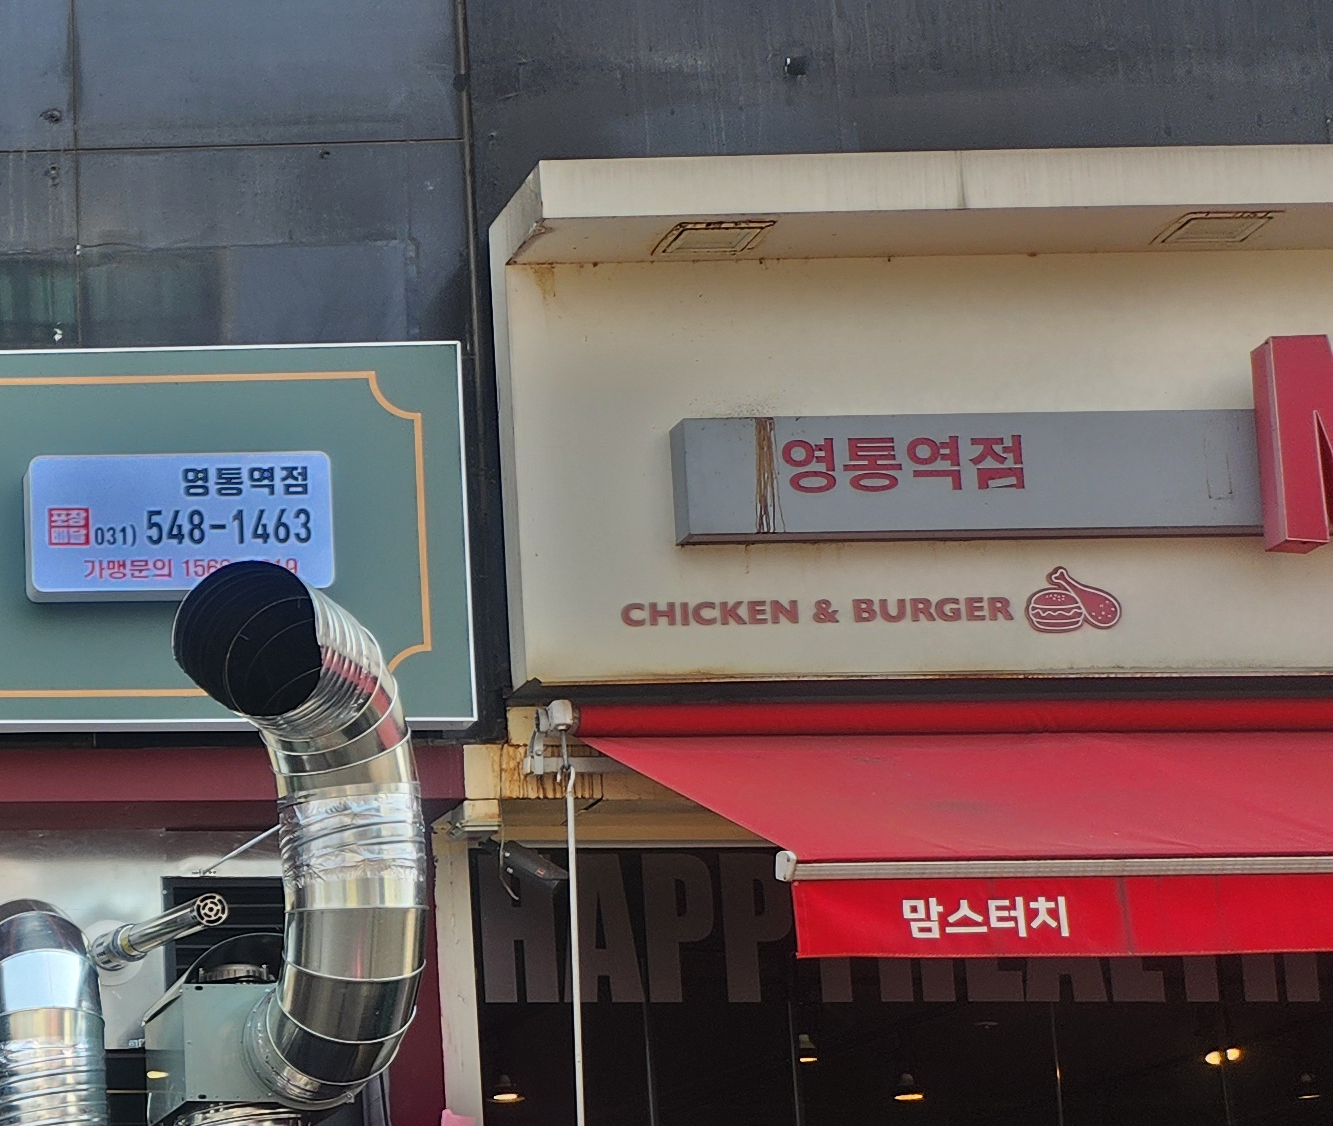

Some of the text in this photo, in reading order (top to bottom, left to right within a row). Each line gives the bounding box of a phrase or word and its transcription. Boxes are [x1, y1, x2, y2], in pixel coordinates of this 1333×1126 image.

[182, 465, 309, 496] 영통역점
[780, 433, 1026, 493] 영통역점
[145, 507, 313, 546] 548-1463
[83, 557, 174, 579] 가맹문의
[620, 595, 1015, 628] CHICKEN & BURGER
[901, 895, 1071, 940] 맘스터치
